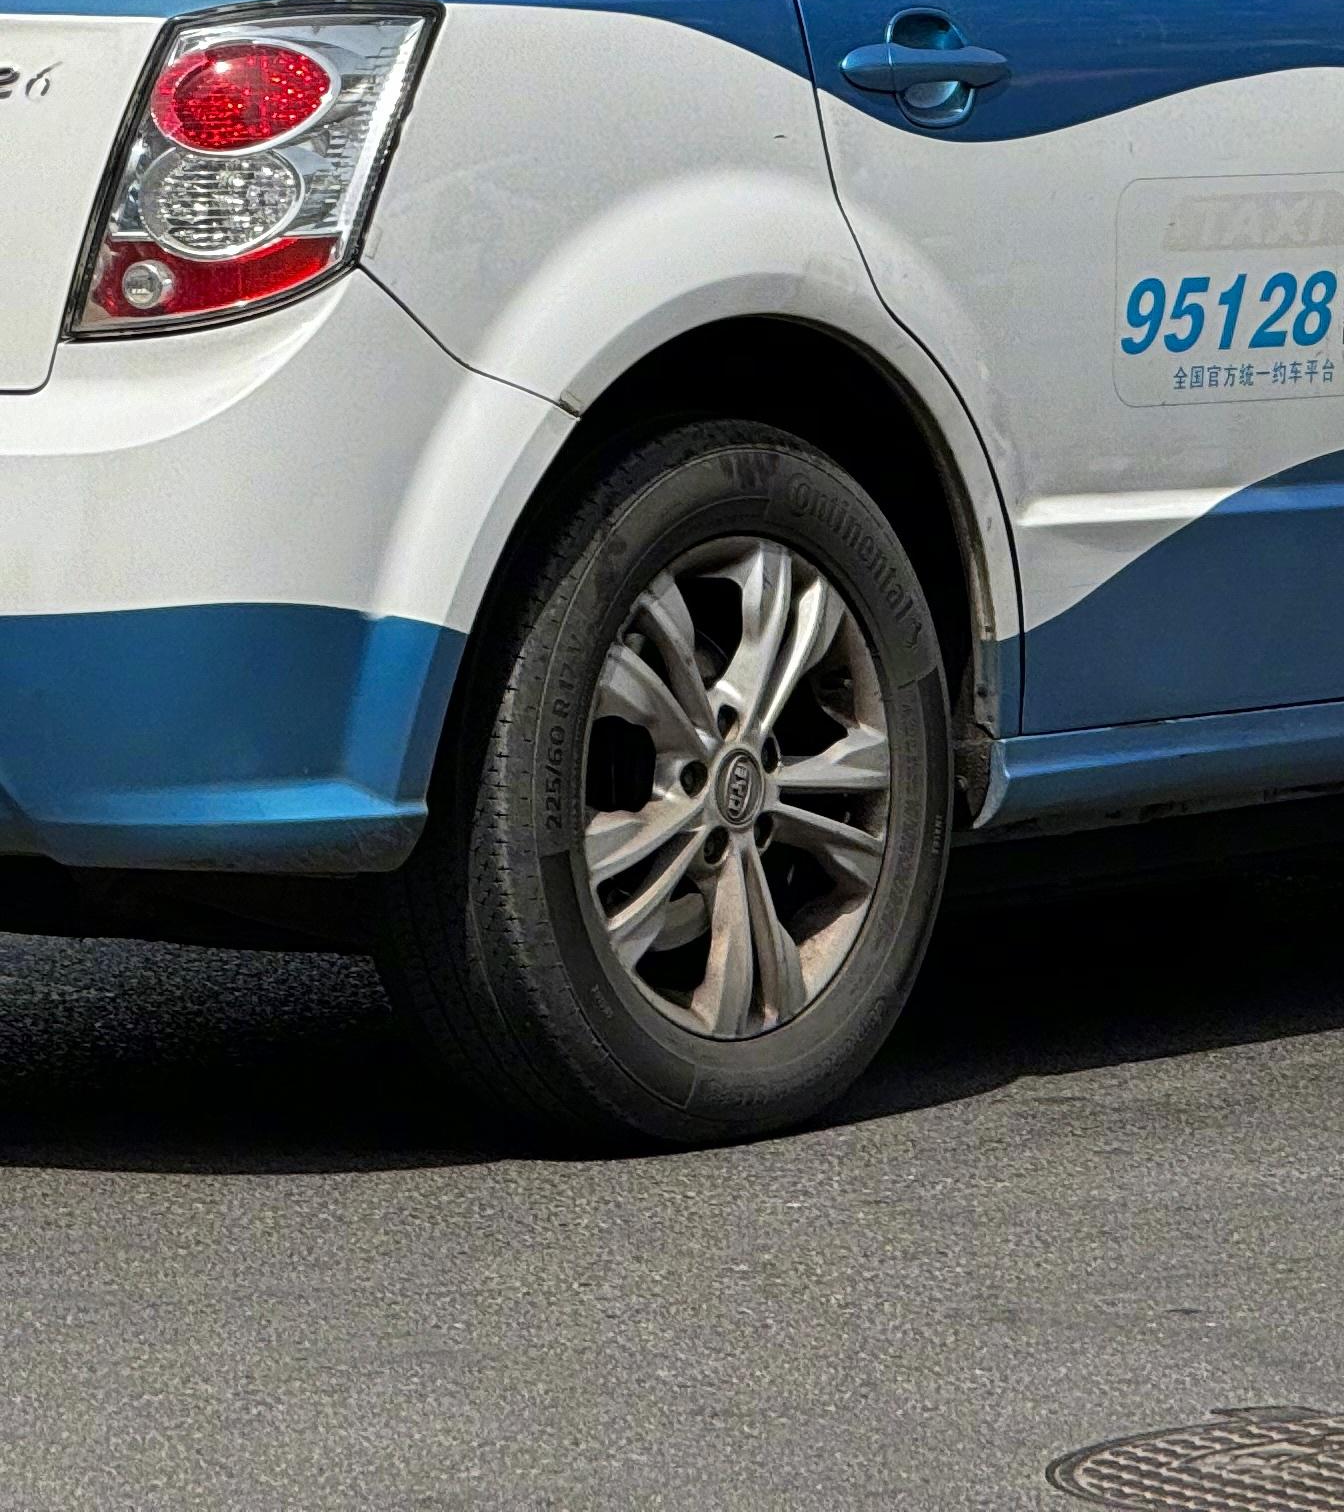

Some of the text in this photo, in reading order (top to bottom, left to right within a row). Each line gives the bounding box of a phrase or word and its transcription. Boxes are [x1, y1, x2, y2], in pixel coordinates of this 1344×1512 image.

[1120, 269, 1339, 356] 95128
[1173, 357, 1336, 391] 全国官方统一约车平台
